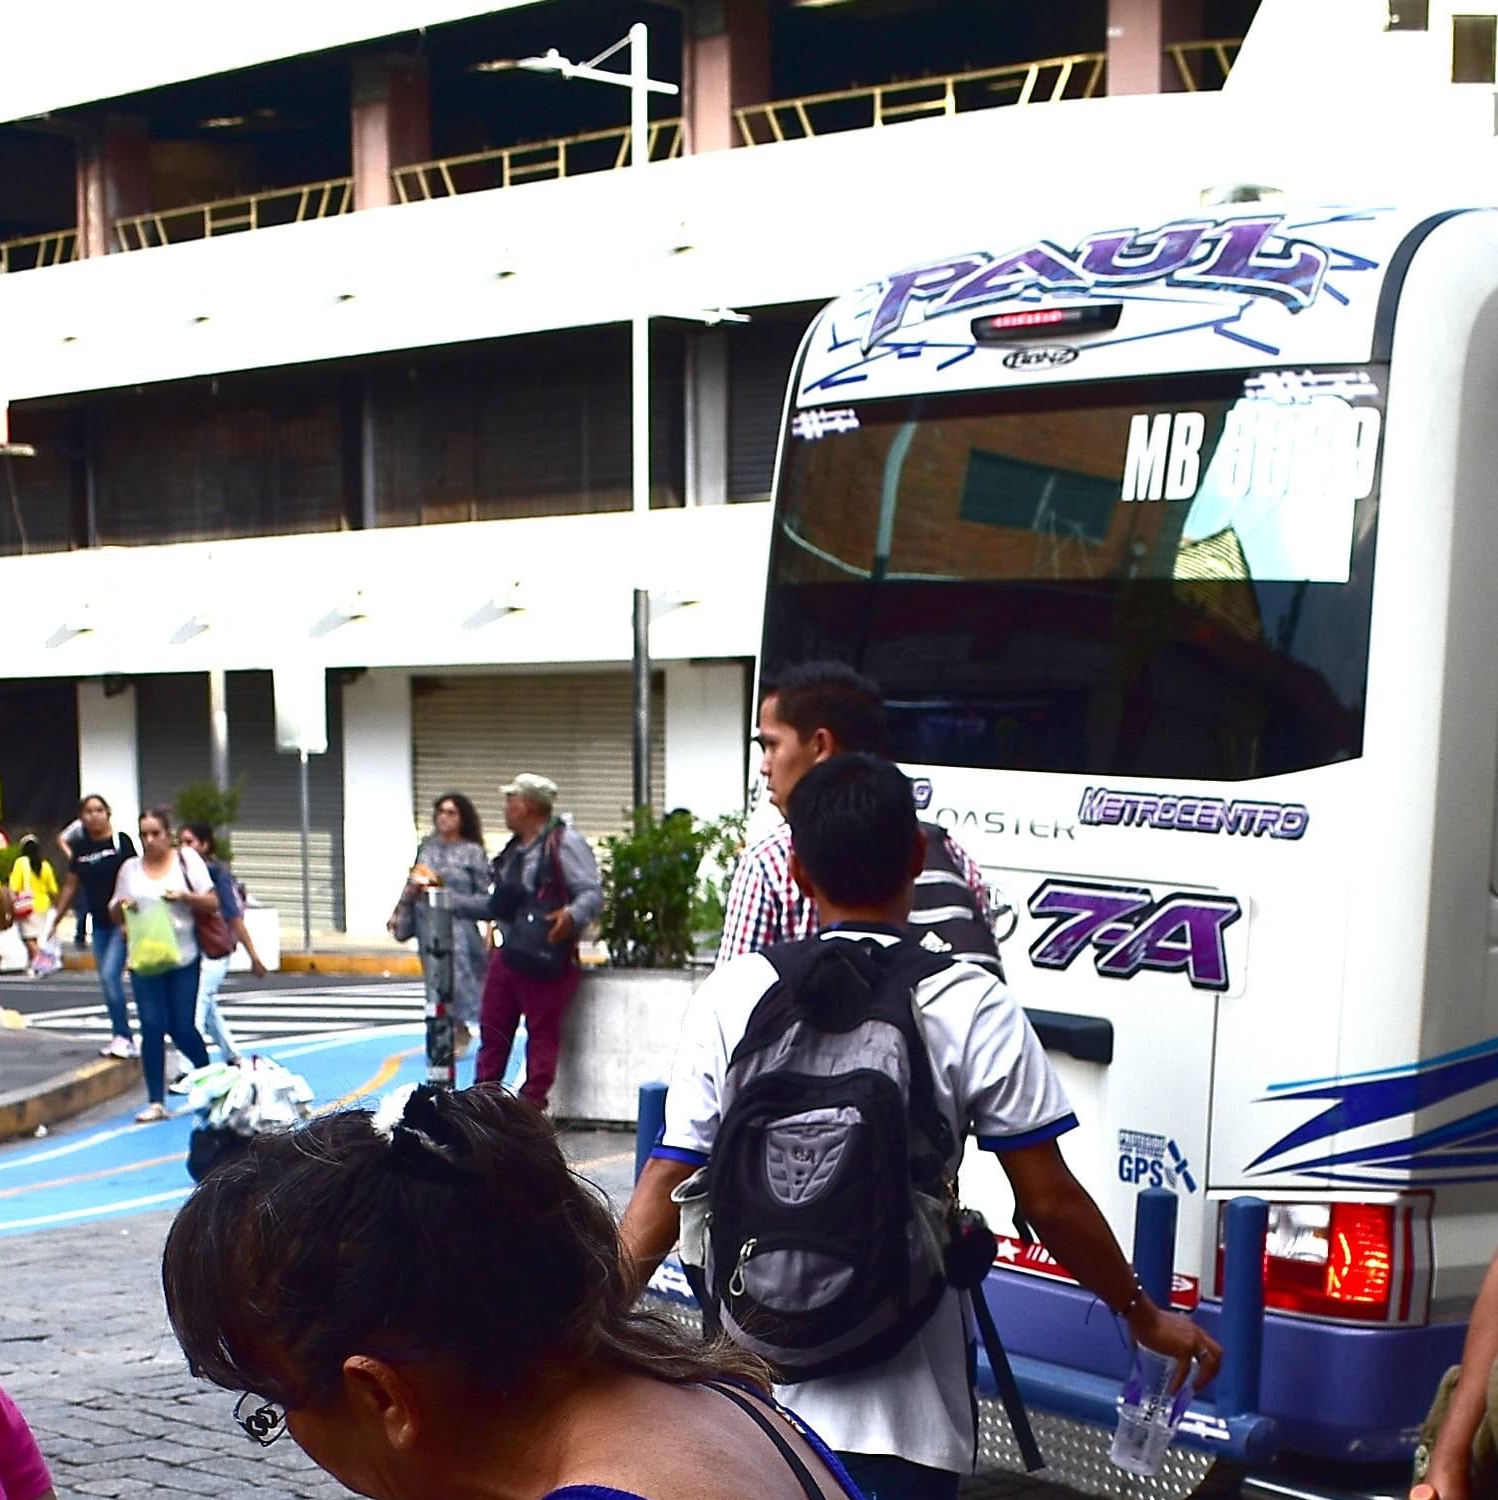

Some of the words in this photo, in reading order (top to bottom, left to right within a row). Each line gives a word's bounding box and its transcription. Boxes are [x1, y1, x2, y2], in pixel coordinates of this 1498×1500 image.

[861, 214, 1331, 355] PAUL
[1121, 411, 1206, 502] MB
[935, 807, 1076, 841] OASTER
[1078, 786, 1310, 841] METROCENTRO
[1118, 1154, 1164, 1187] GPS
